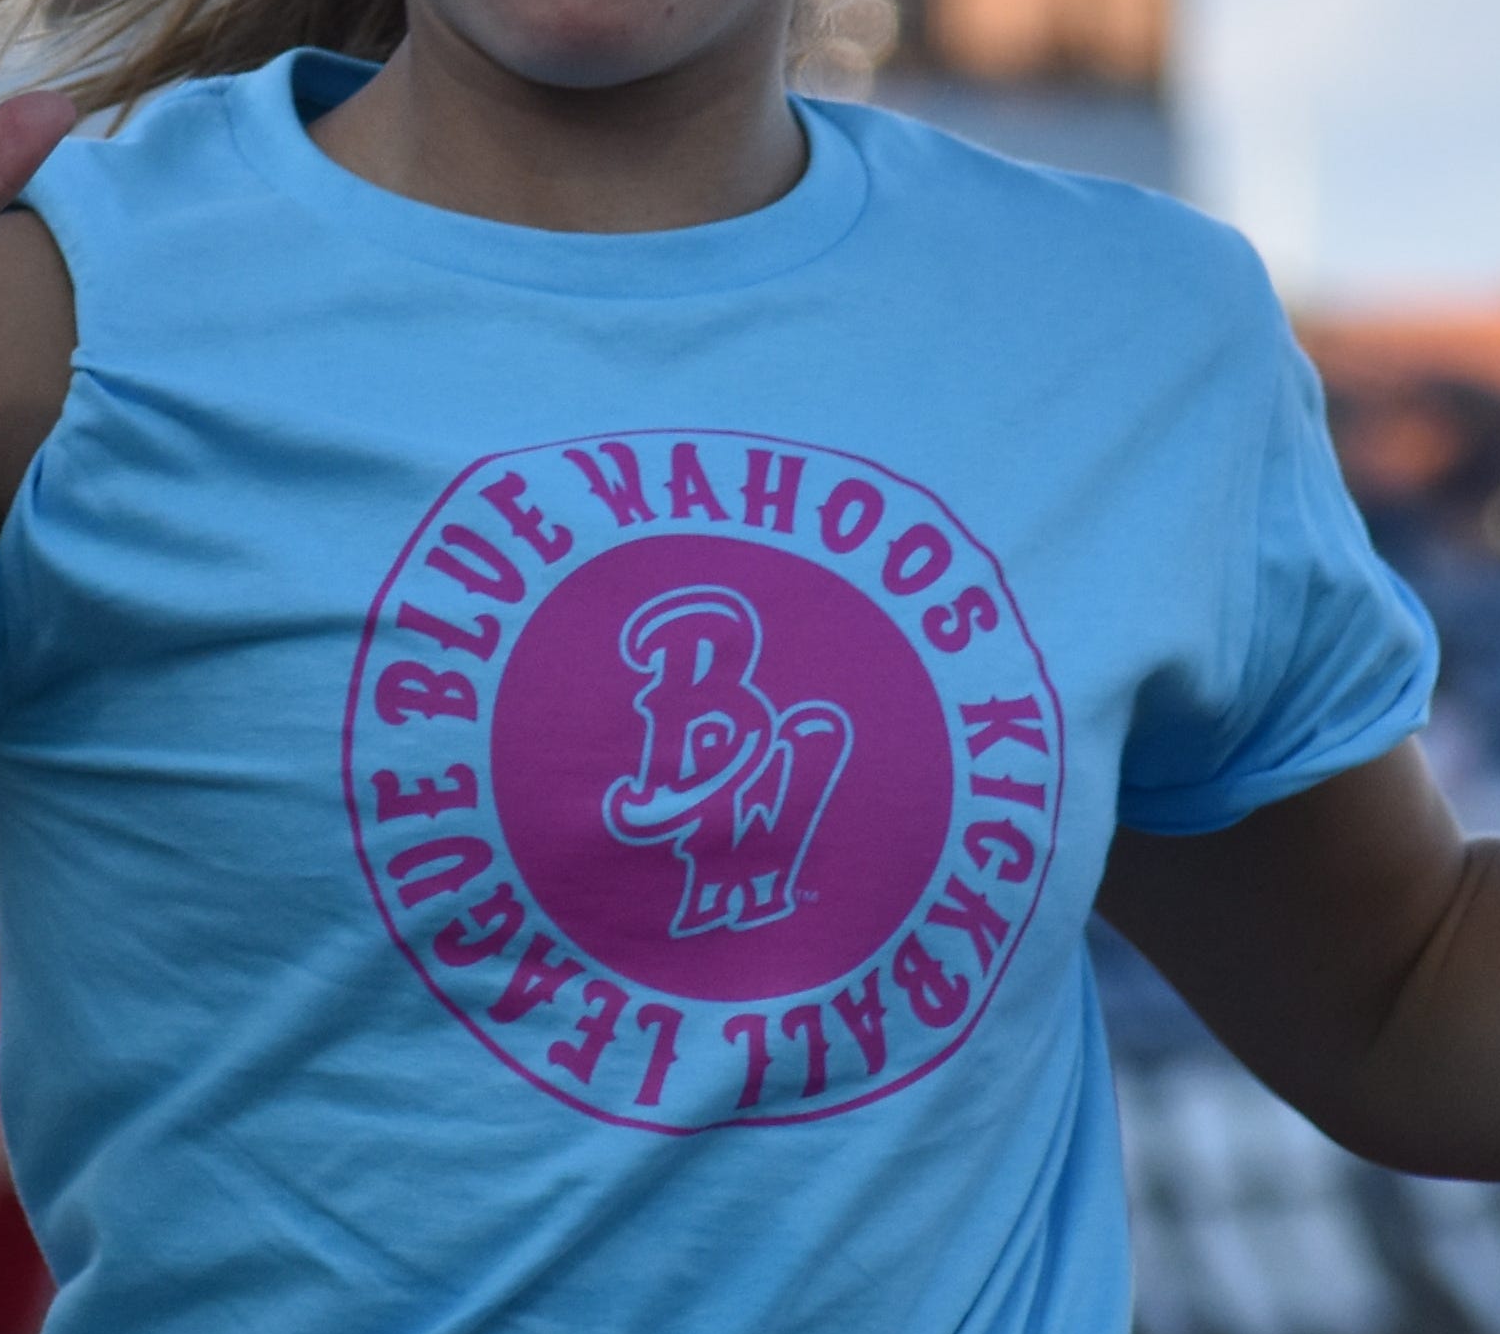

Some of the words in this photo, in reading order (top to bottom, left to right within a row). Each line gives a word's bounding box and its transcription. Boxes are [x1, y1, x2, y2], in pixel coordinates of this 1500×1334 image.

[374, 471, 574, 728] BLUE
[563, 441, 998, 654] WAHOOS
[374, 763, 683, 1106] LEAGUE
[723, 695, 1050, 1109] KICKBALL
